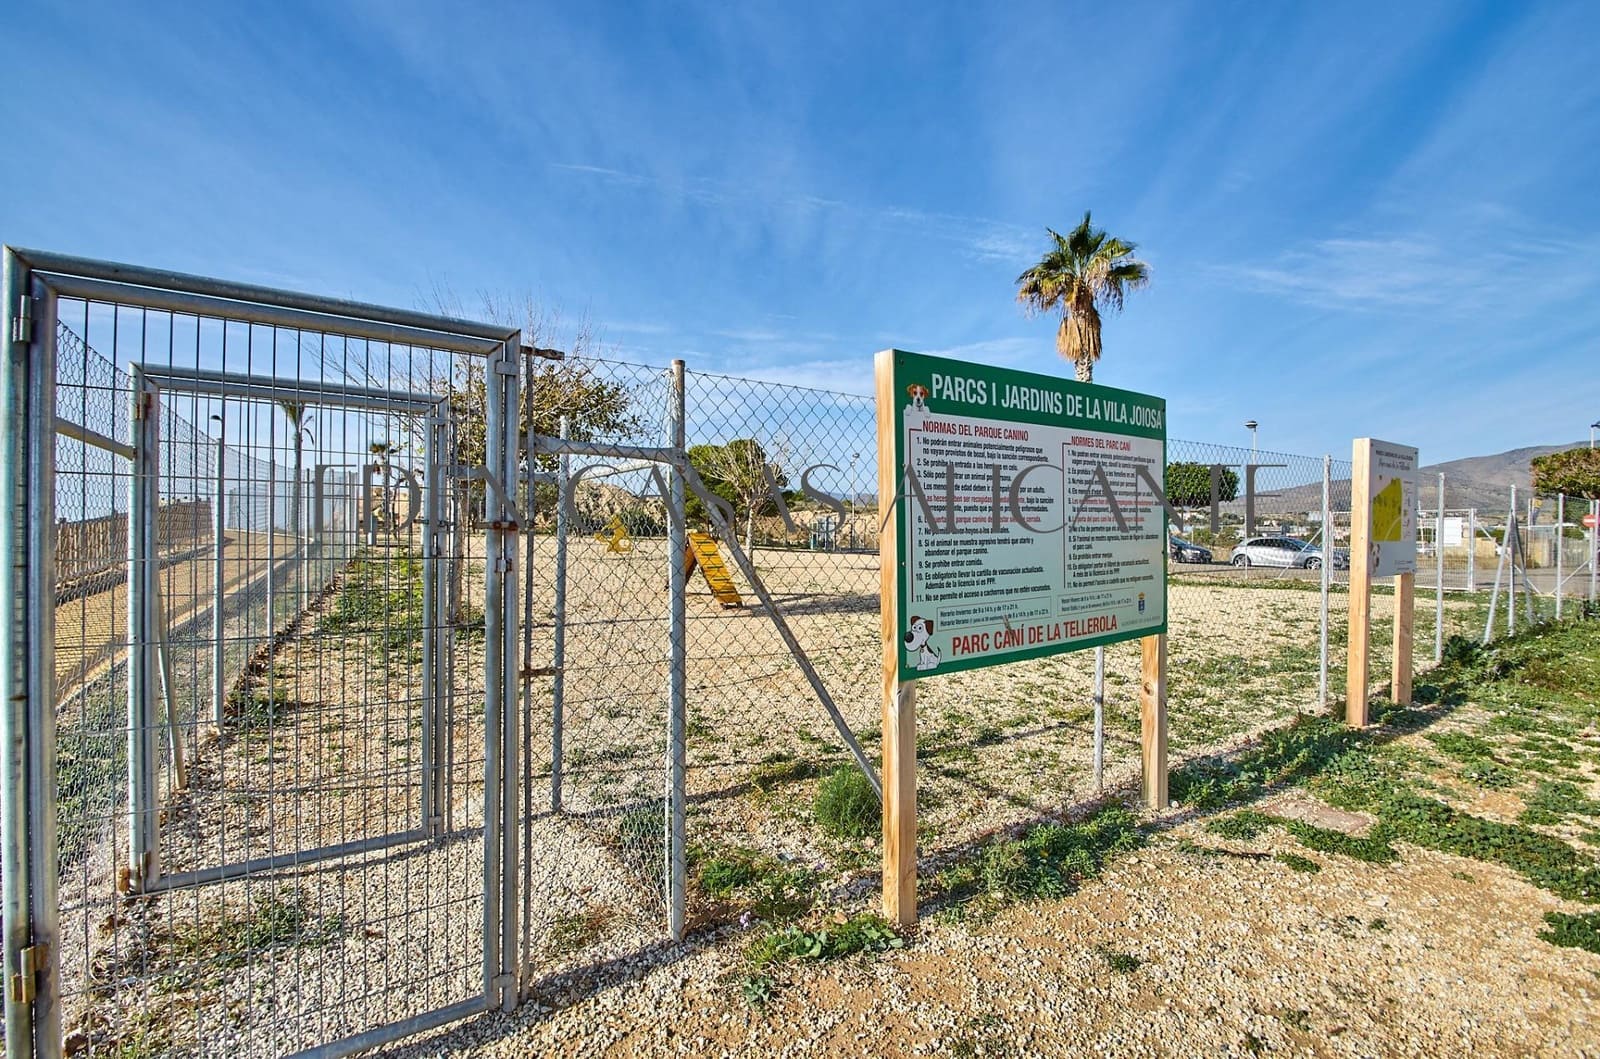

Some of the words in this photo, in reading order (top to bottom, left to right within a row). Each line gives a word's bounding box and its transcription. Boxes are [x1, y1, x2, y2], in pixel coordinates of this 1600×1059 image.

[932, 373, 987, 405] PARCS
[992, 382, 996, 406] I
[1002, 384, 1062, 414] JARDINS
[1066, 394, 1082, 418] DE
[1086, 397, 1101, 420] LA
[1104, 400, 1128, 424] VILA
[1130, 405, 1162, 430] JOIOSA
[922, 420, 957, 435] NORMAS
[958, 424, 972, 436] DEL
[974, 426, 1002, 439] PARQUE
[1004, 428, 1028, 442] CANINO
[922, 437, 930, 445] No
[1072, 436, 1094, 448] NORMES
[1096, 439, 1104, 448] DEL
[1106, 440, 1118, 450] PARC
[952, 632, 990, 656] PARC
[994, 624, 1024, 650] CANÍ
[1028, 626, 1044, 644] DE
[1047, 622, 1061, 641] LA
[1064, 614, 1118, 638] TELLEROLA
